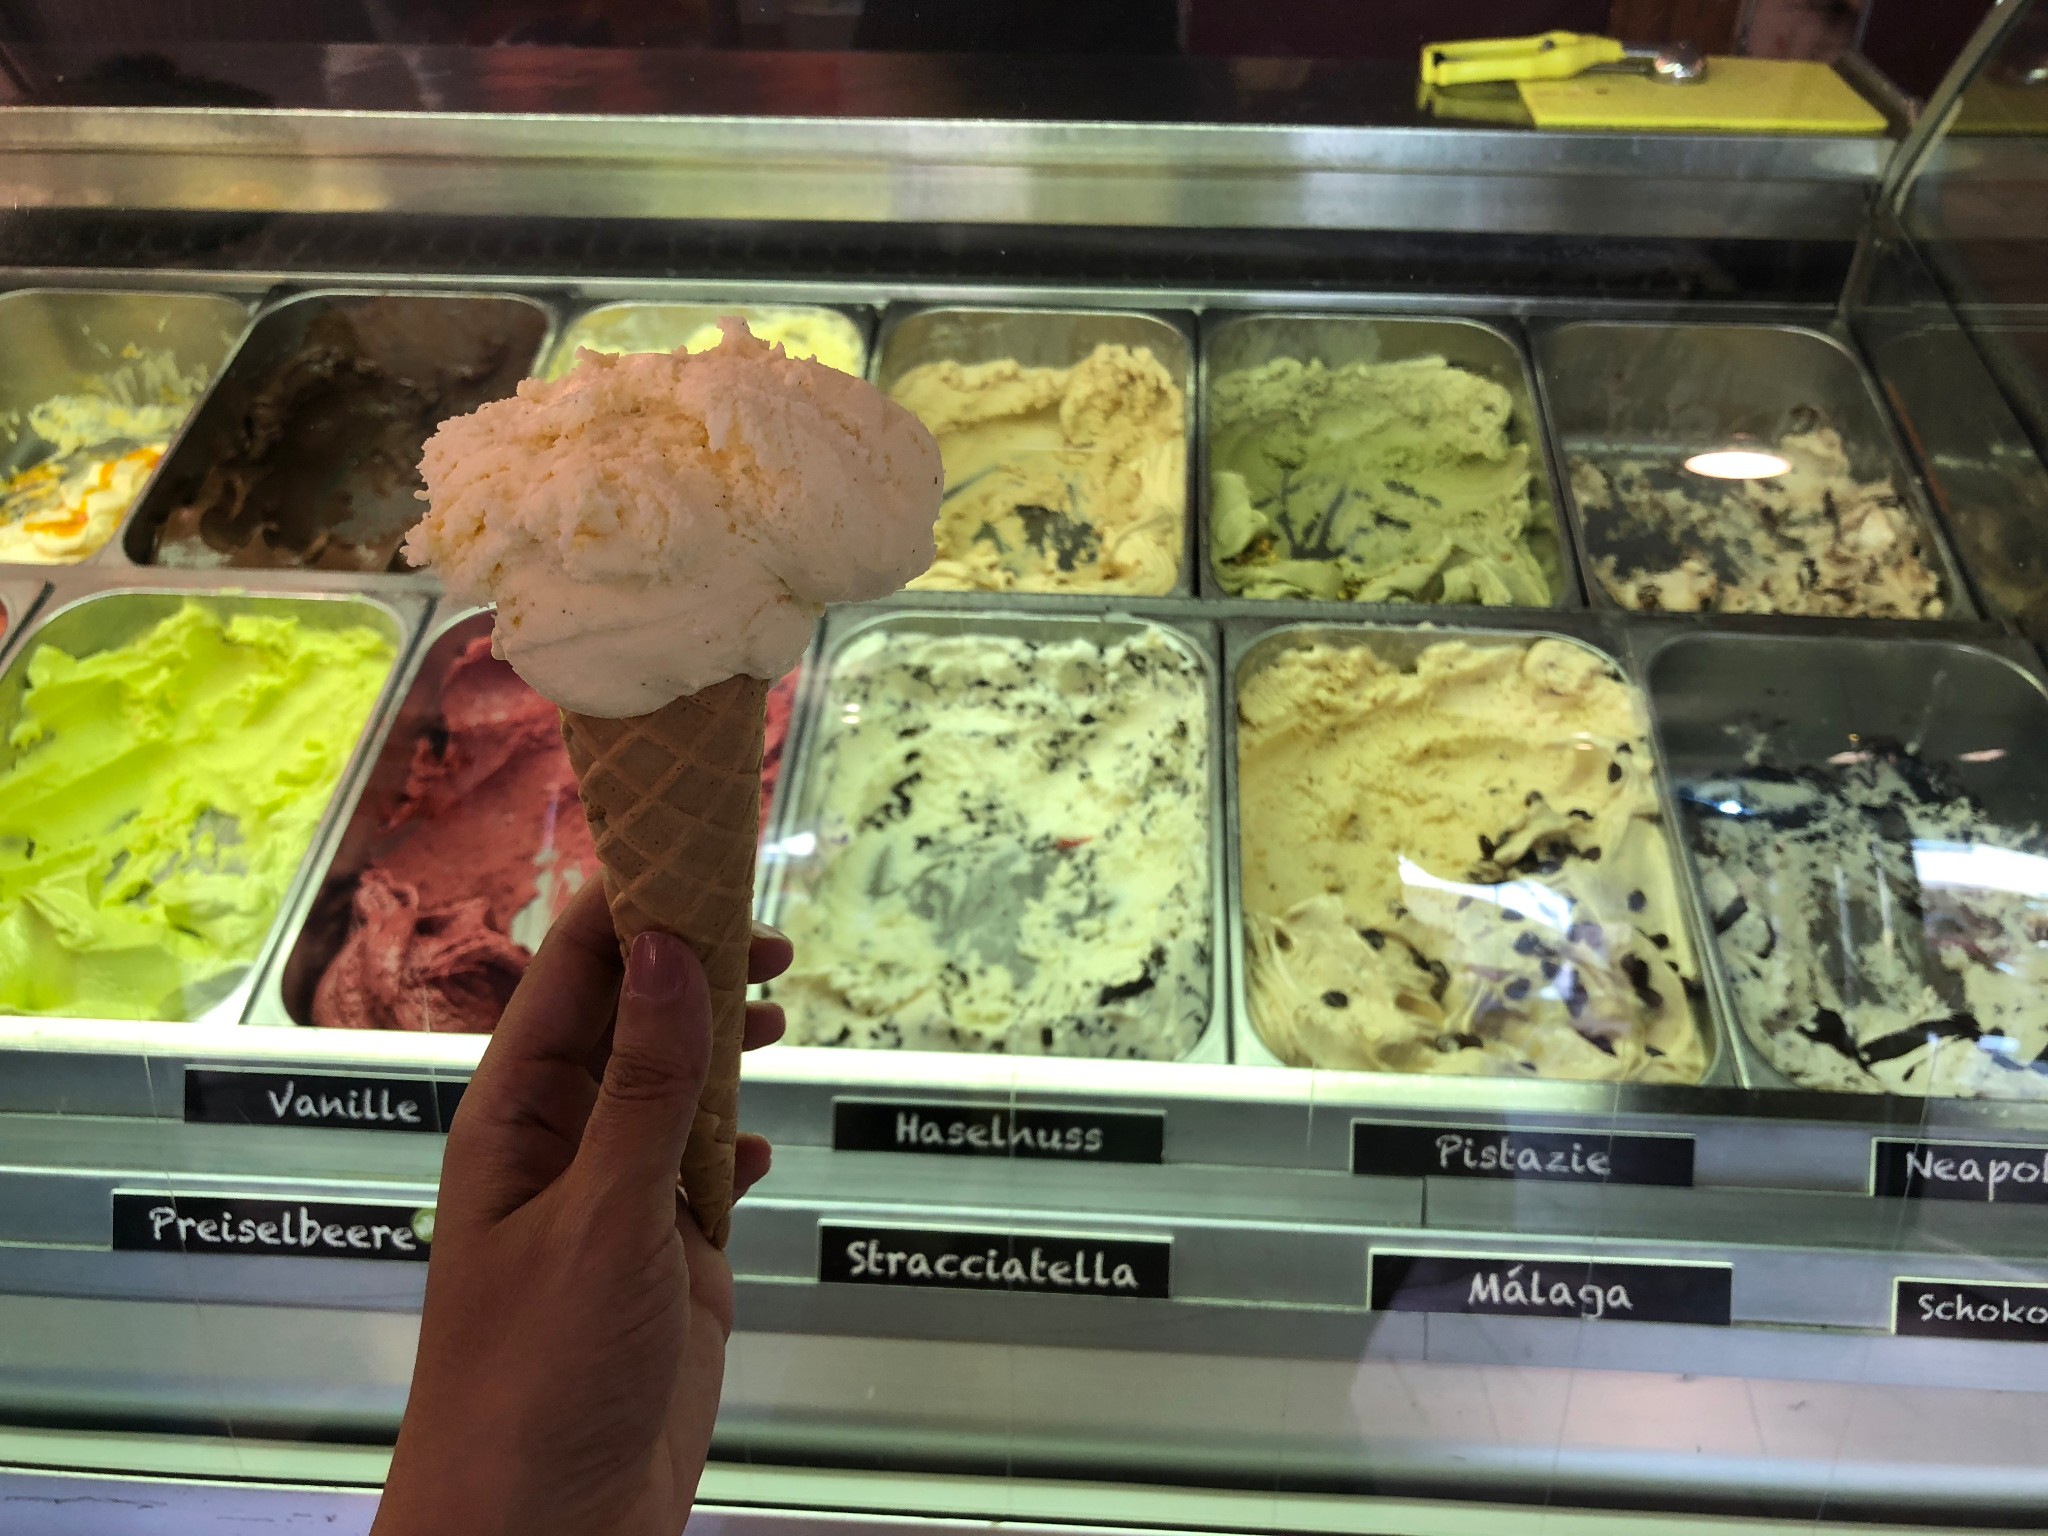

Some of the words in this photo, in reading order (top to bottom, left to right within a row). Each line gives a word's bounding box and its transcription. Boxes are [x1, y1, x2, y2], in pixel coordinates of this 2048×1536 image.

[268, 1080, 421, 1124] Vanille
[895, 1111, 1104, 1153] Haselnuss
[1436, 1134, 1612, 1176] Pistazie
[149, 1206, 416, 1251] Preiselbeere
[846, 1239, 1139, 1290] Stracciatella
[1467, 1265, 1634, 1319] Málaga
[1918, 1293, 2048, 1325] Schoko
